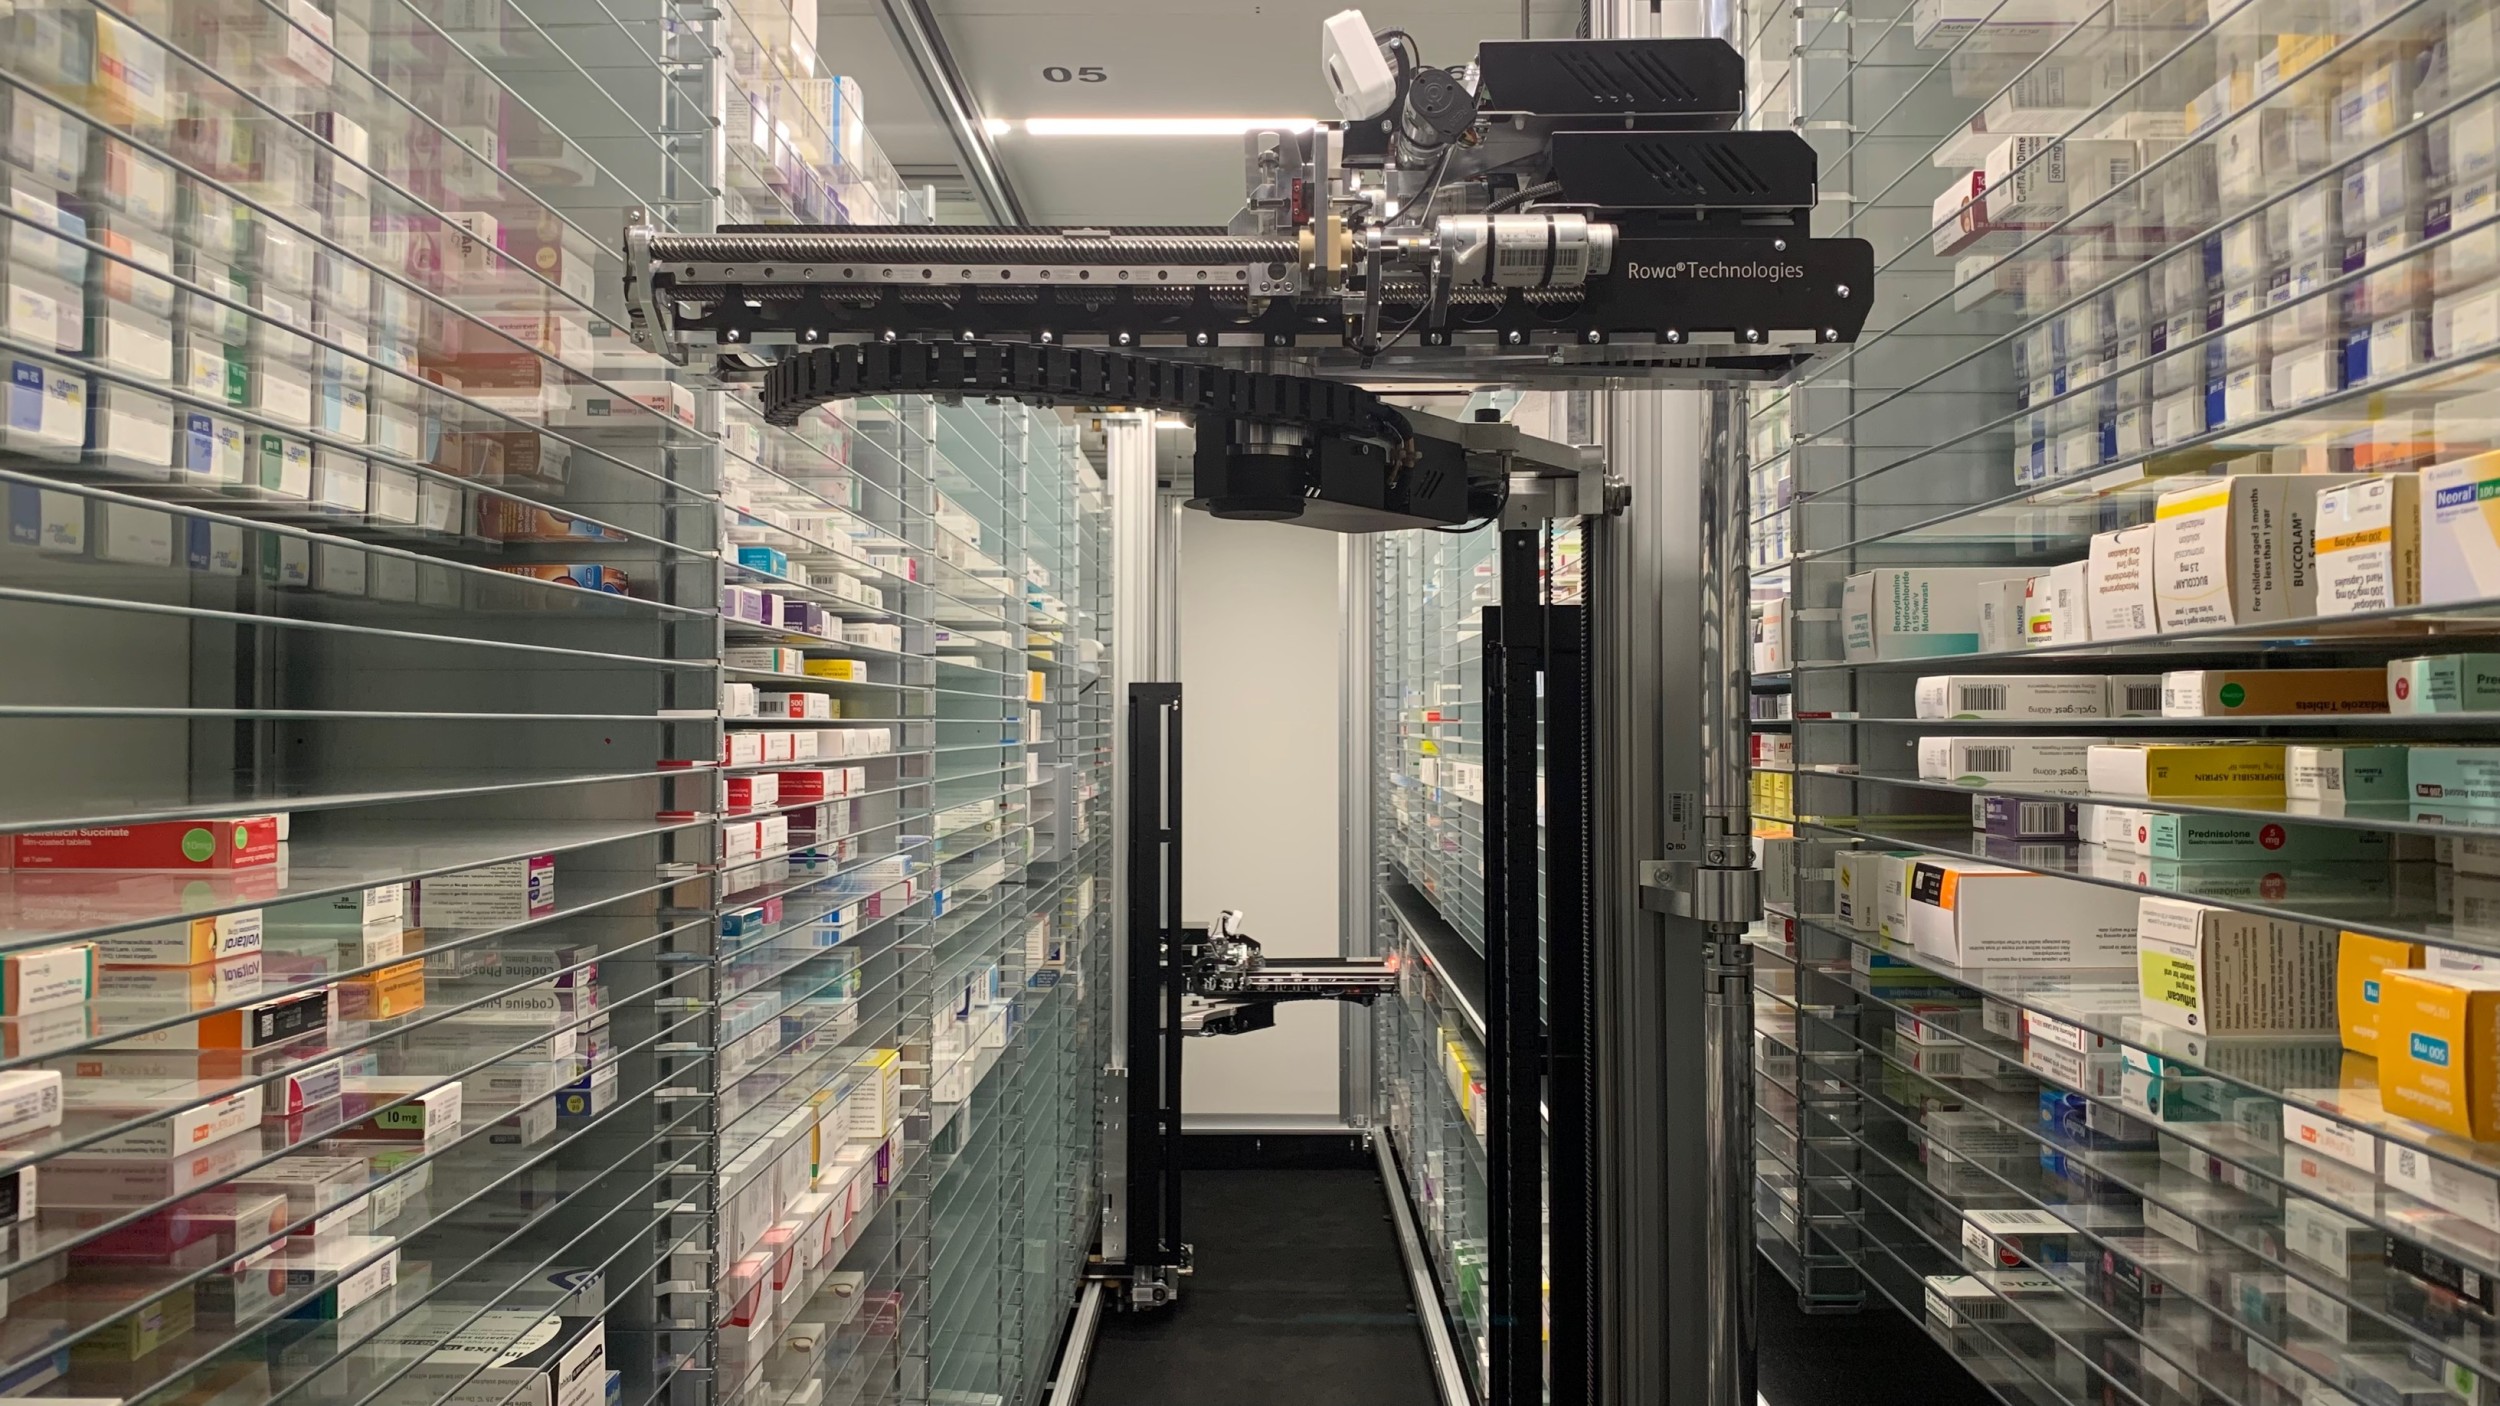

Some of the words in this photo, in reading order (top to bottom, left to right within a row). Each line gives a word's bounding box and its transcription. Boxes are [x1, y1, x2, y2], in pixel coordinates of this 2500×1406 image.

[1043, 67, 1107, 83] 05
[2052, 146, 2061, 161] mg
[2051, 164, 2061, 179] 500
[1688, 261, 1804, 282] Technologies
[2478, 486, 2494, 498] 100
[2180, 562, 2189, 573] mg
[2190, 563, 2199, 572] 2.5
[2335, 574, 2364, 588] Capsules
[2365, 573, 2383, 585] Hard
[2336, 589, 2346, 600] mg
[2370, 586, 2384, 598] 200
[1893, 575, 1902, 632] Benzydamine
[1902, 571, 1910, 632] Hydrochloride
[1921, 582, 1929, 632] Mouthwash
[2028, 706, 2052, 714] 400mg
[2296, 700, 2337, 713] Tablets
[2033, 768, 2057, 776] 400mg
[2195, 773, 2229, 781] ASPIRIN
[80, 828, 129, 837] Succinate
[2188, 830, 2250, 838] Prednisolone
[66, 838, 91, 846] tablets
[2265, 837, 2279, 846] mg
[223, 933, 260, 952] Voltarol
[2414, 1038, 2427, 1054] mg
[2428, 1044, 2446, 1062] 500
[387, 1111, 399, 1123] 10
[402, 1113, 417, 1123] mg
